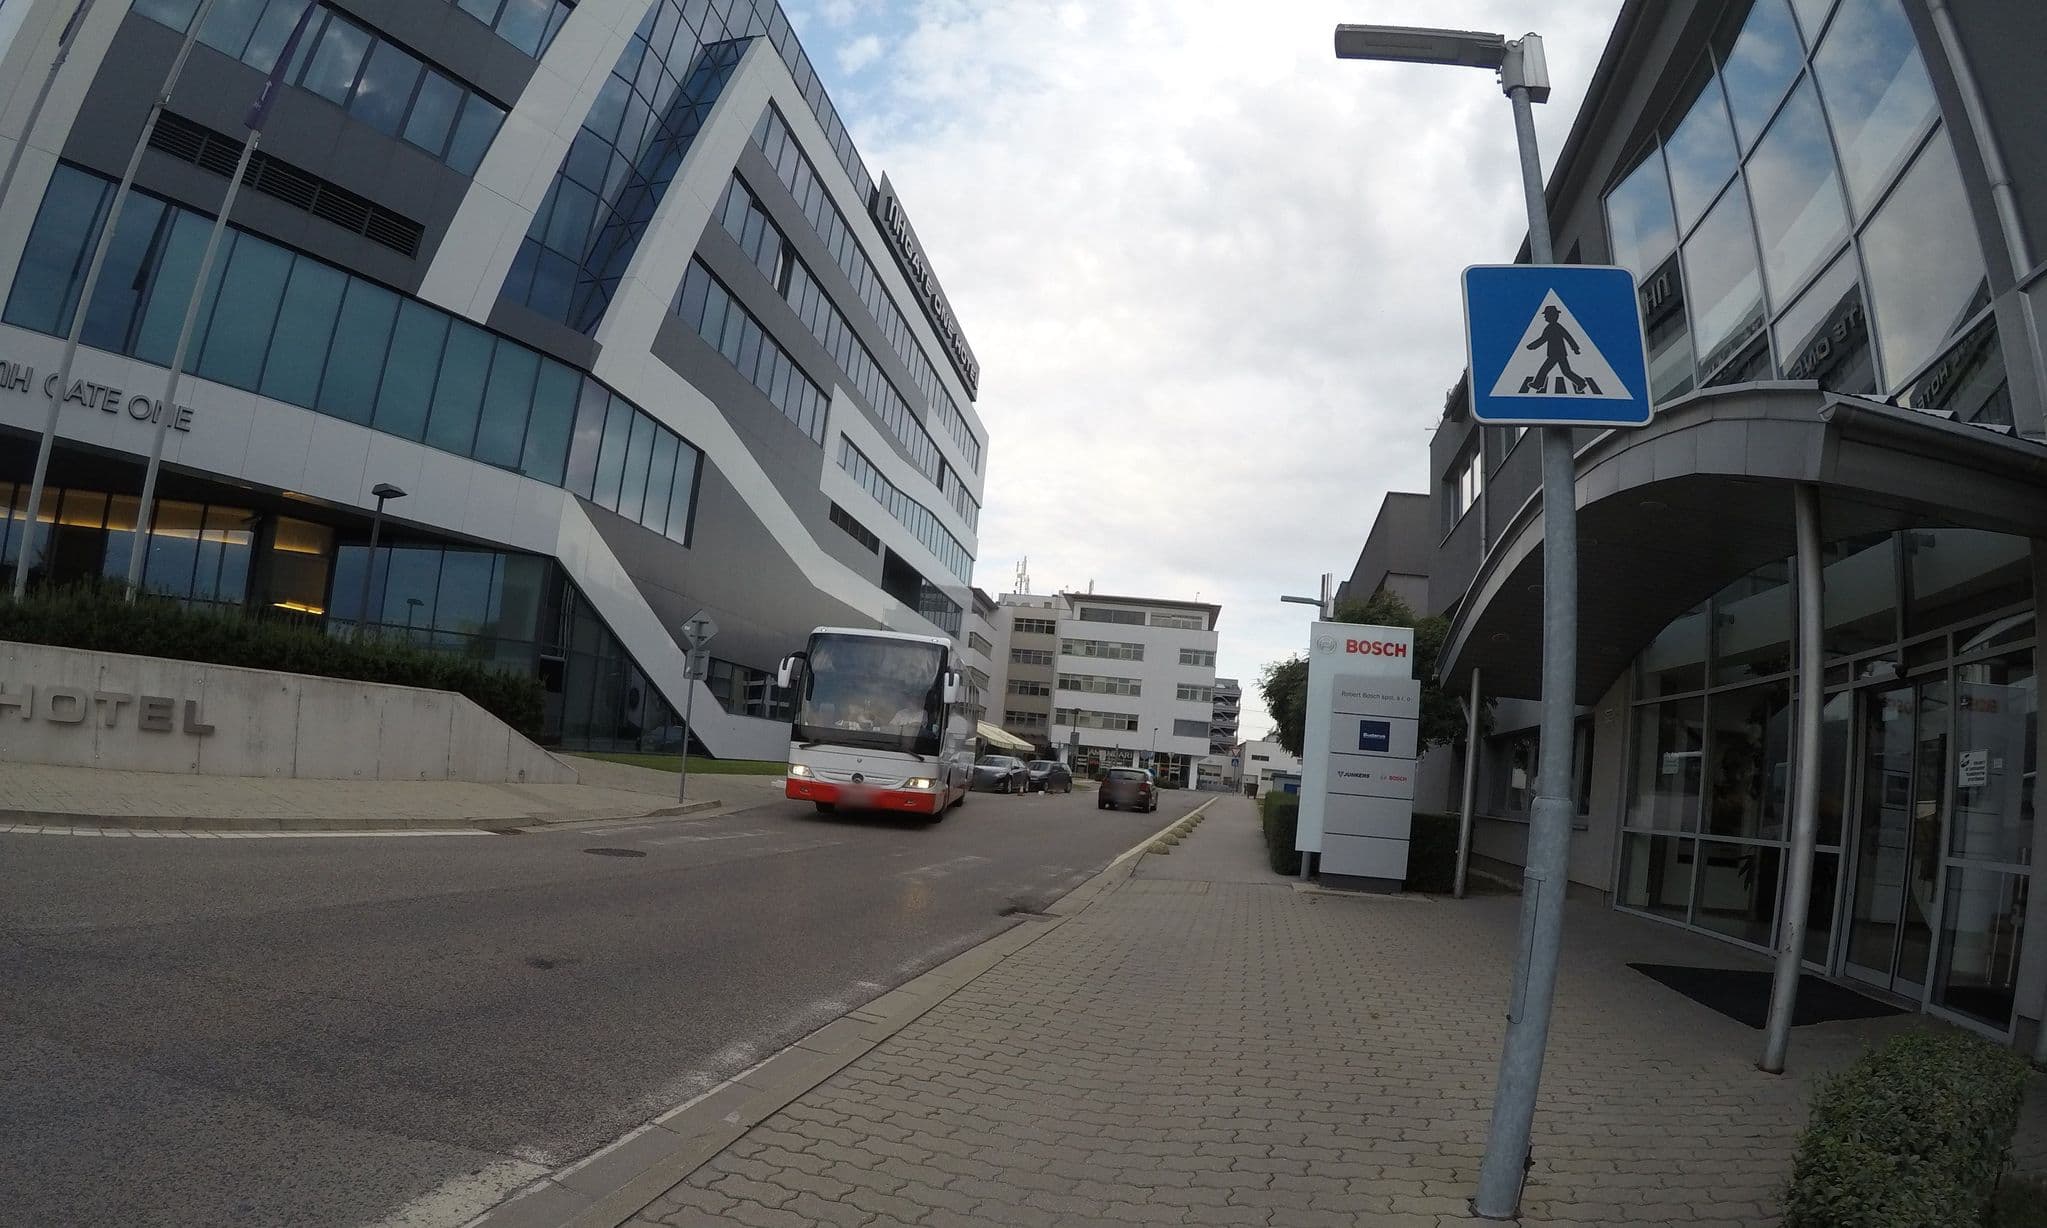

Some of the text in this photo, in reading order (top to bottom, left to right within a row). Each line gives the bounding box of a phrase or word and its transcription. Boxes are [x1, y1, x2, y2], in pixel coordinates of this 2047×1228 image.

[901, 235, 933, 296] GATE
[931, 295, 954, 338] ONE
[952, 334, 978, 390] HOTEL
[1346, 639, 1407, 658] BOSCH
[0, 682, 215, 735] HOTEL
[1362, 691, 1380, 699] Bosch
